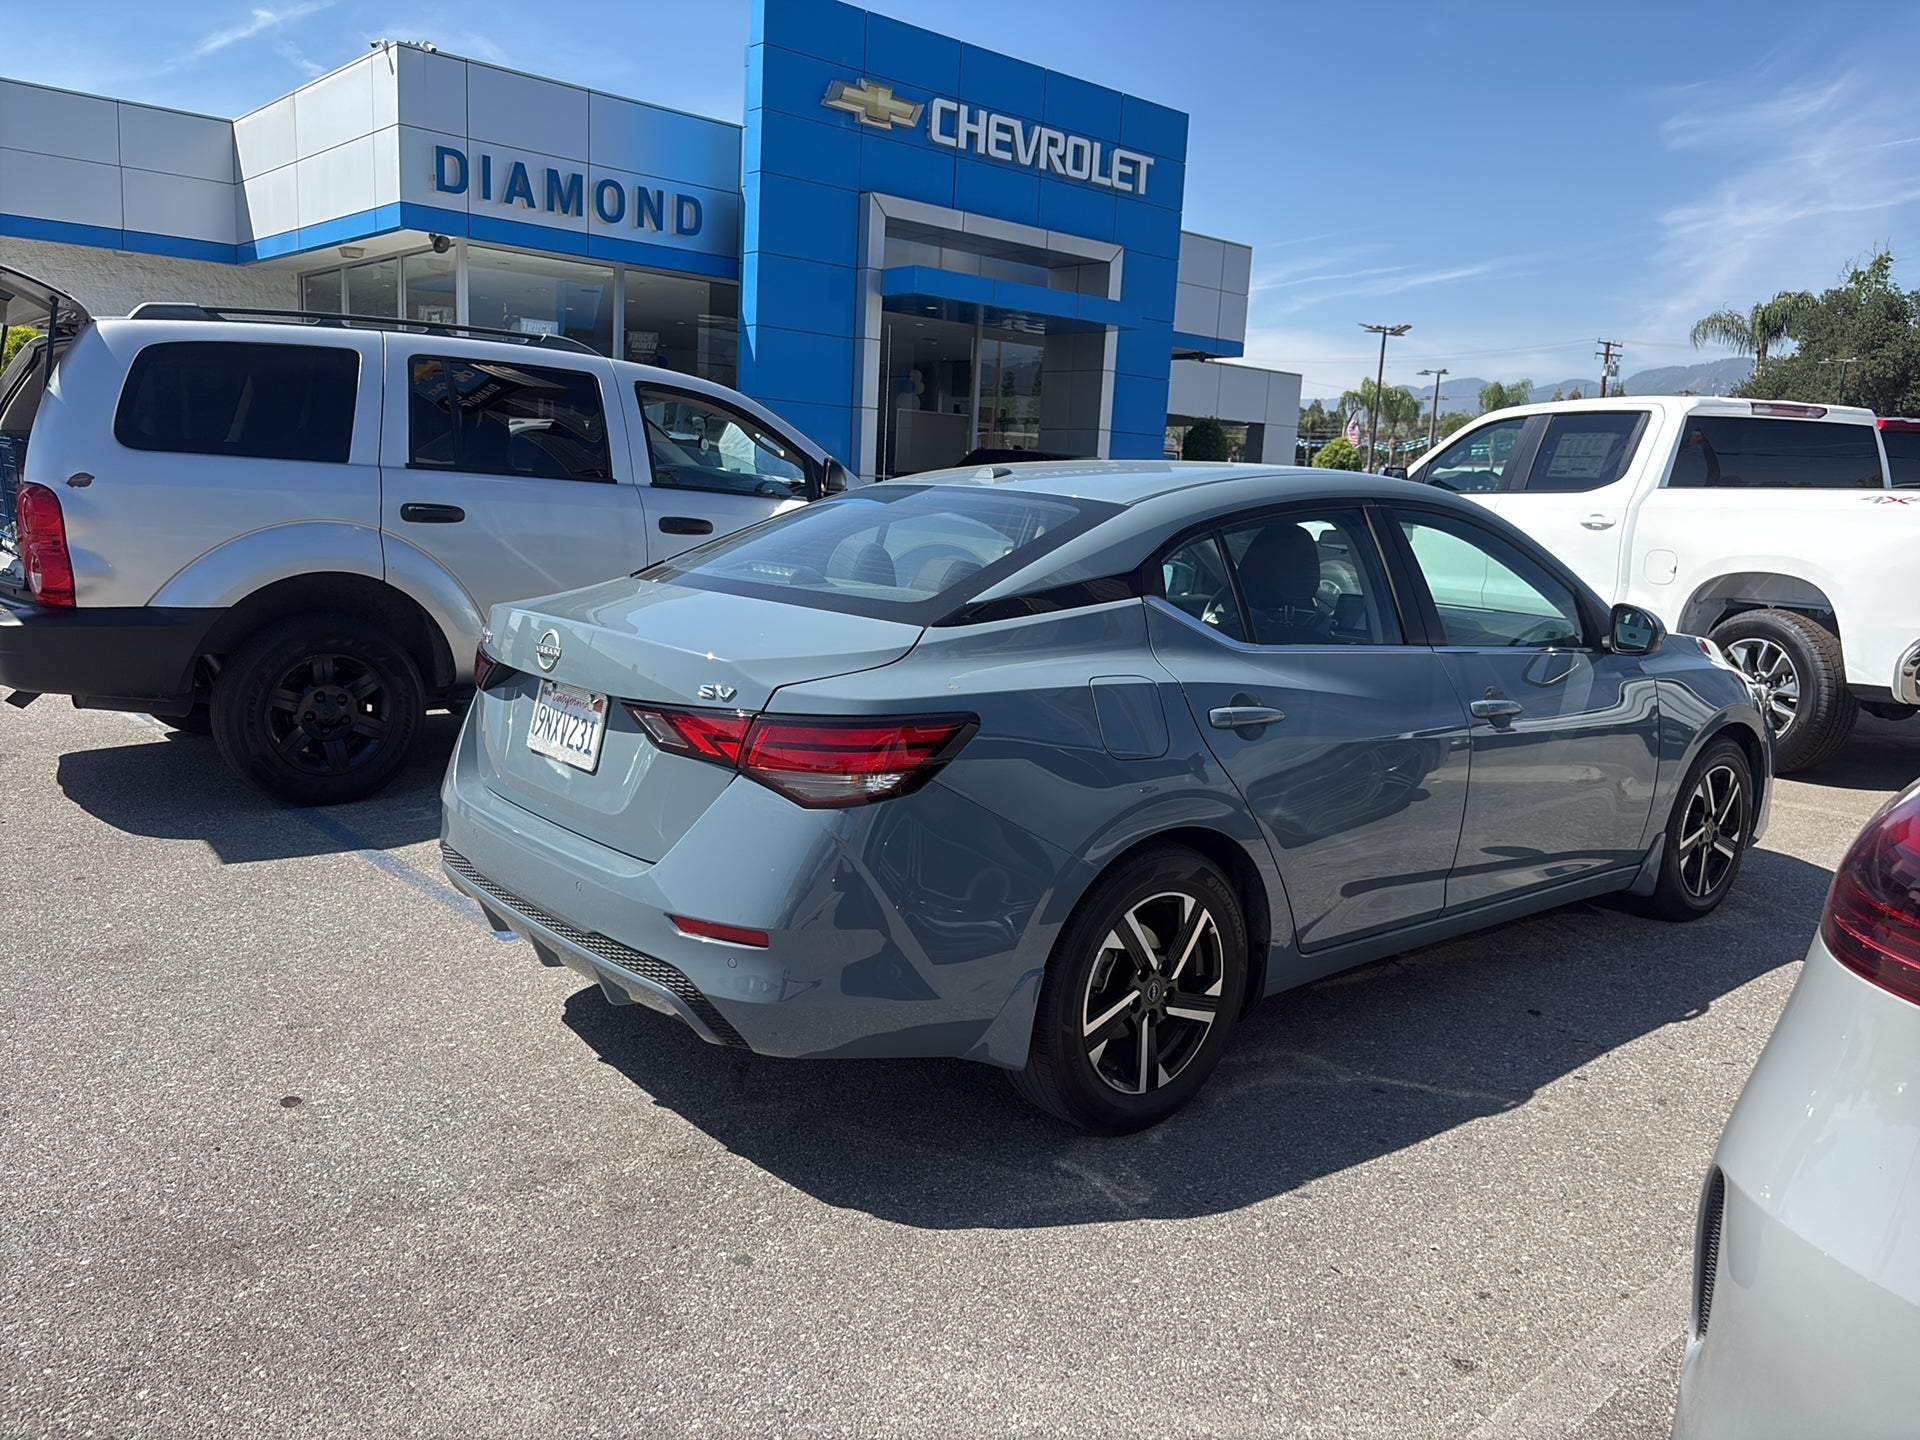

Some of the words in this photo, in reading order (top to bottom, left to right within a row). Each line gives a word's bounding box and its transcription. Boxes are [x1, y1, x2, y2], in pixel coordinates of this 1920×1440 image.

[928, 97, 1154, 195] CHEVROLET
[433, 144, 704, 237] DIAMOND
[522, 320, 553, 334] TRUCK
[697, 684, 738, 703] SV
[534, 705, 596, 756] 9NXV231
